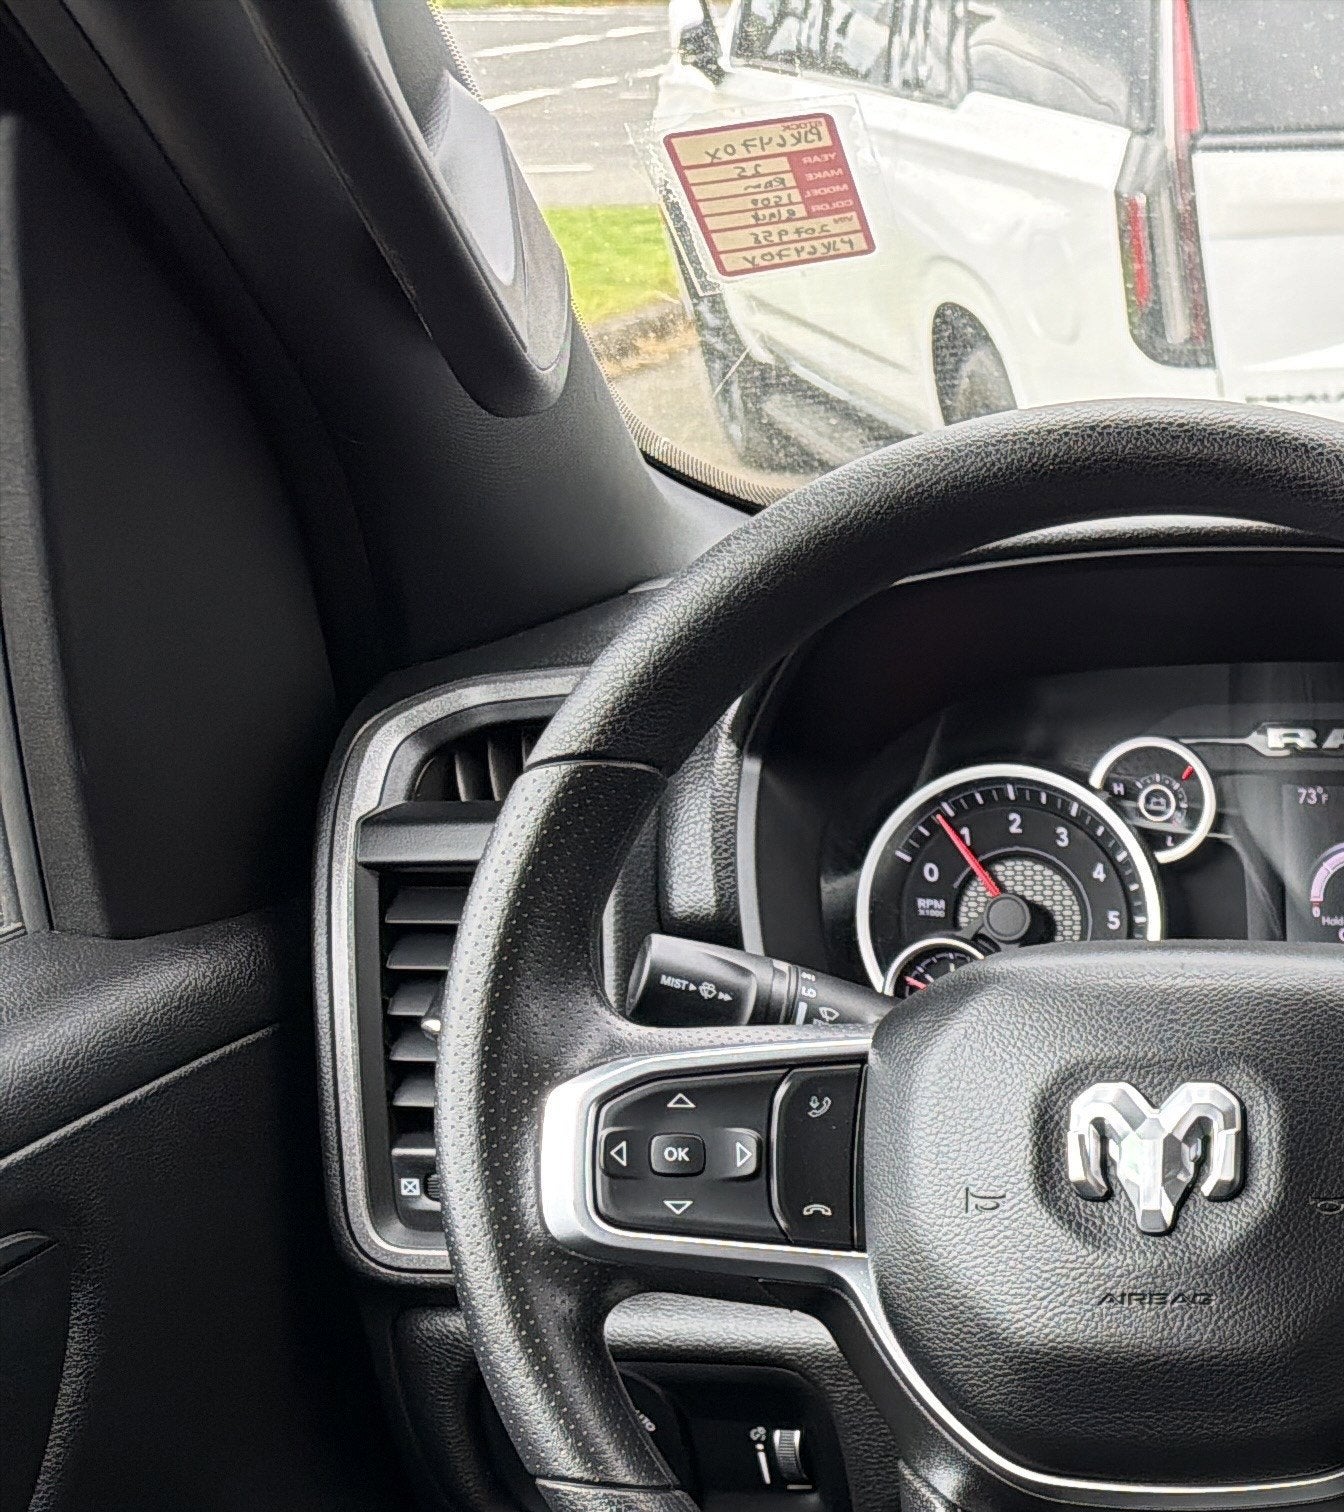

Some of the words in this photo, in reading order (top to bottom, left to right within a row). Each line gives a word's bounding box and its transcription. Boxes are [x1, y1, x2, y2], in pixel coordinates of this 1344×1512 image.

[1008, 812, 1023, 834] 2
[959, 826, 972, 847] 1
[1055, 826, 1069, 847] 3
[923, 862, 940, 883] 0
[1092, 862, 1107, 883] 4
[917, 898, 946, 911] RPM
[1106, 910, 1121, 930] 5
[660, 973, 690, 992] MIST
[663, 1146, 690, 1163] OK
